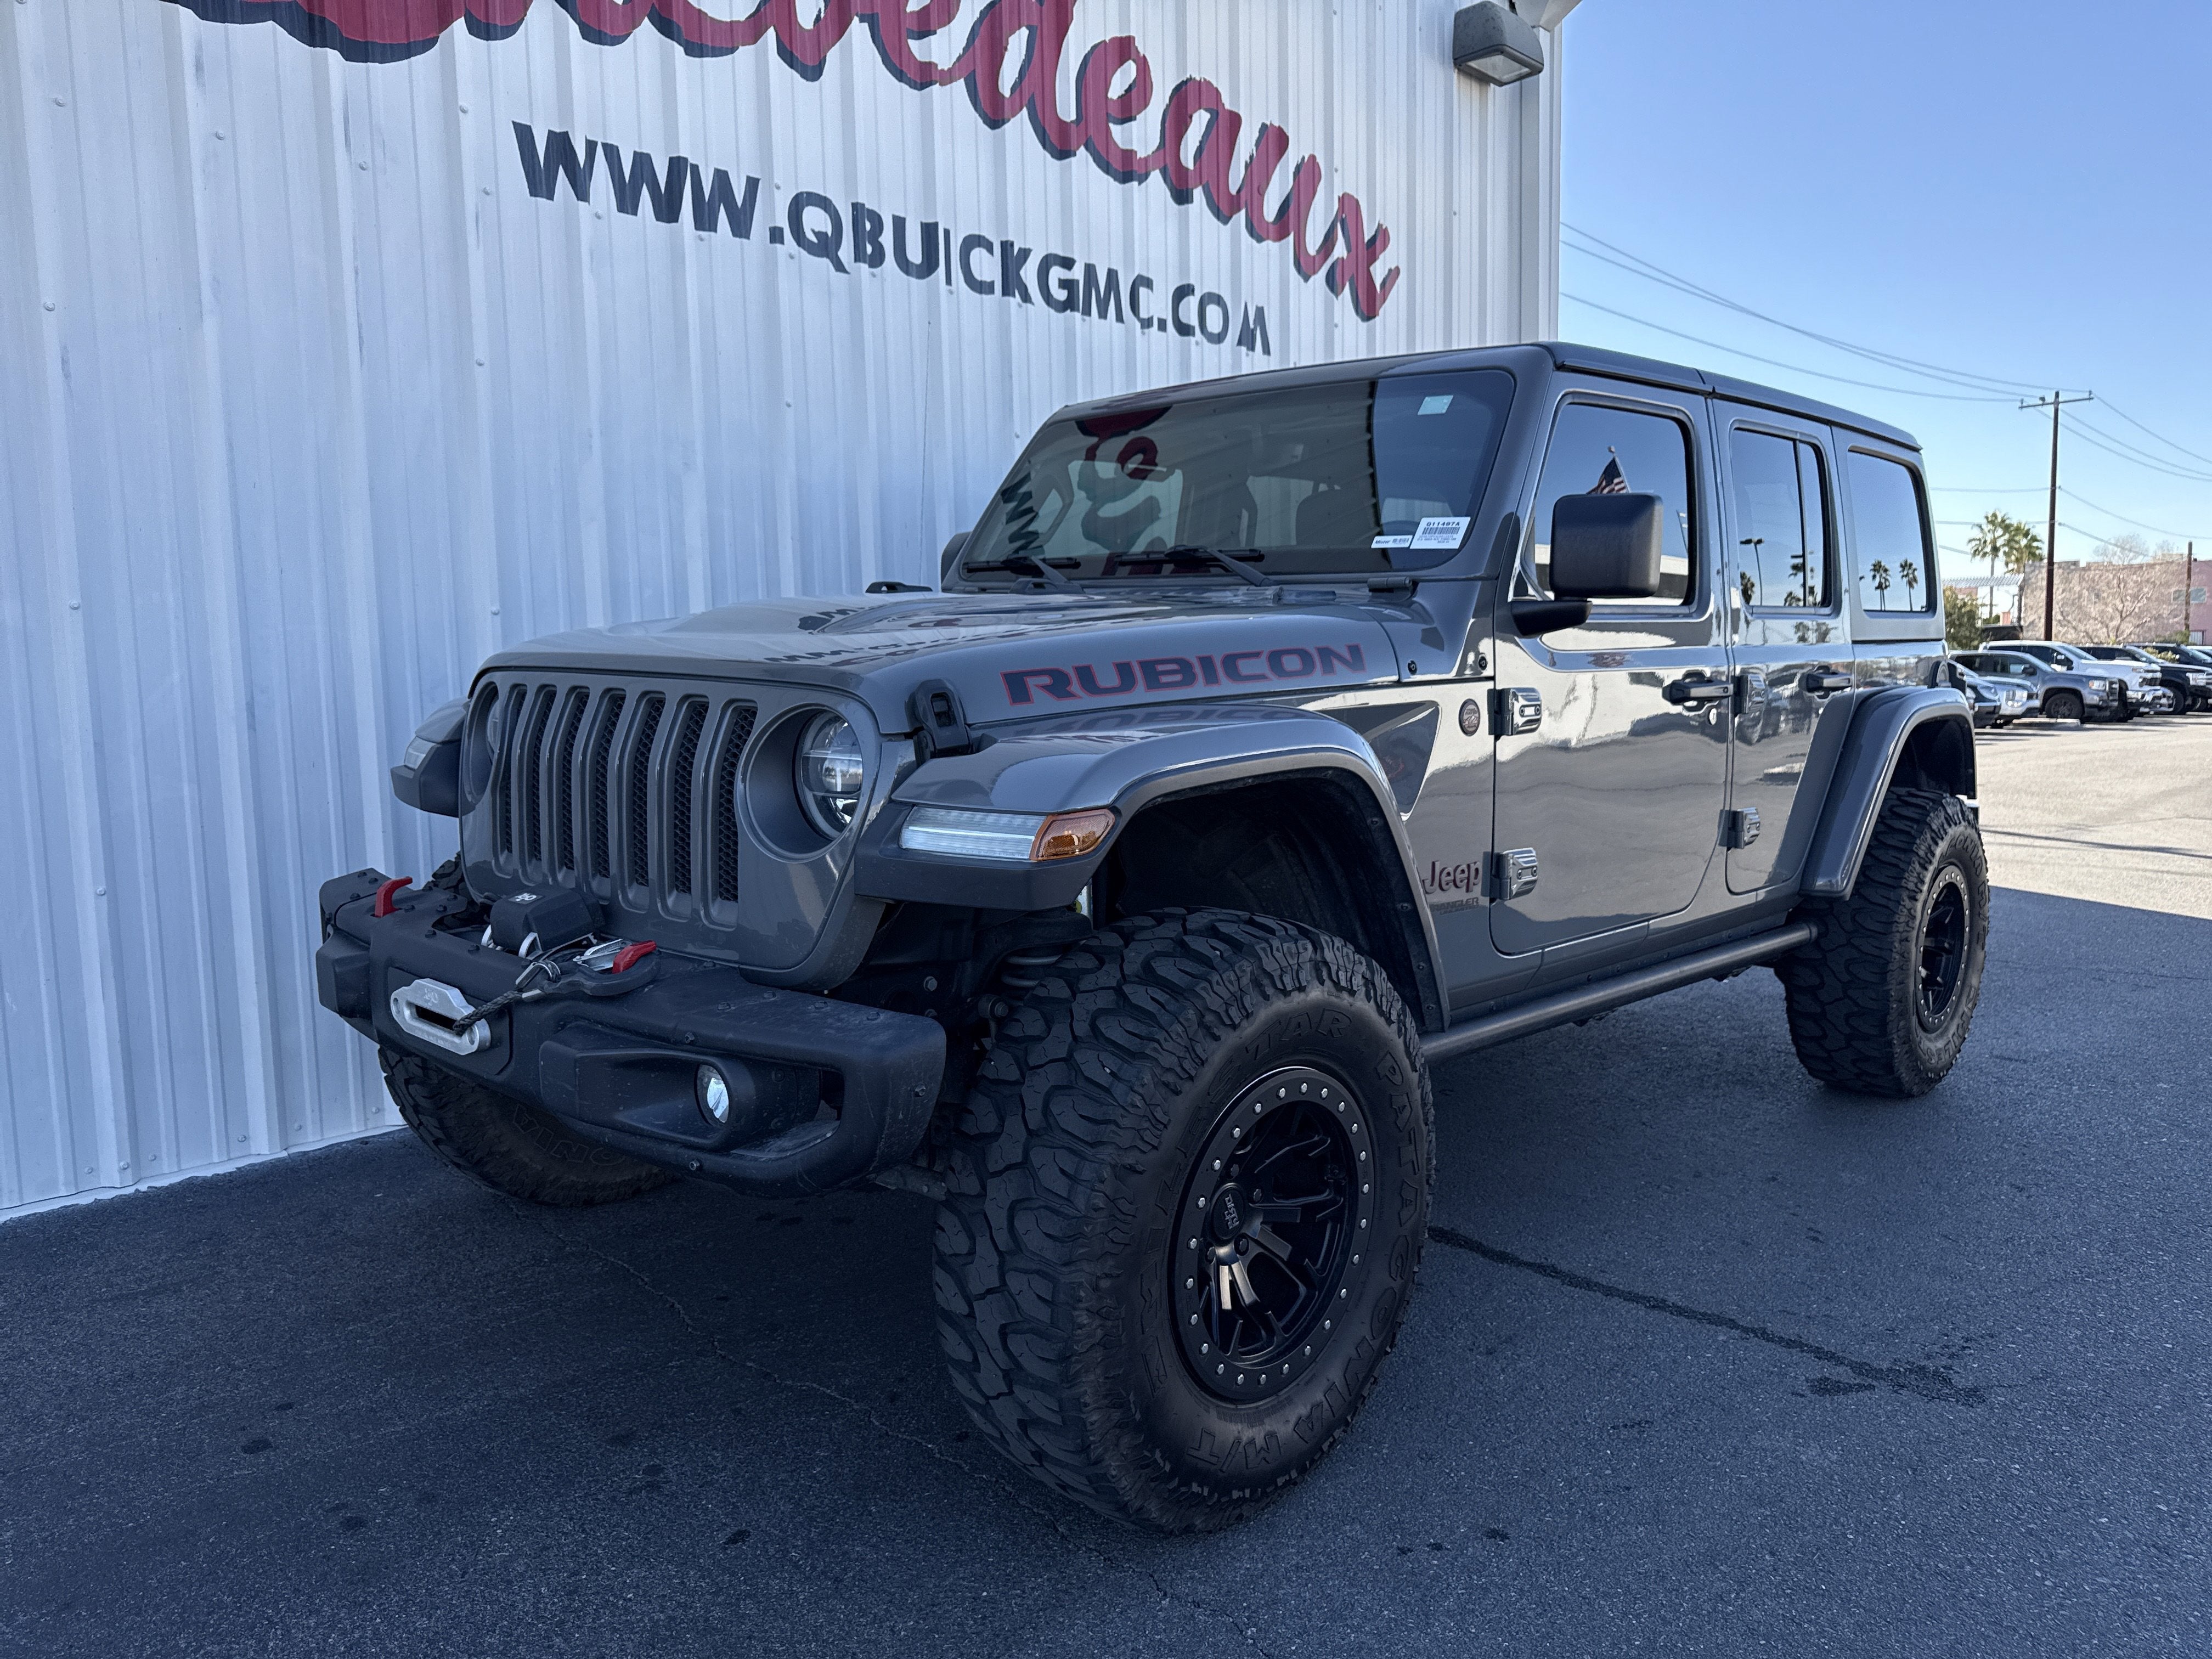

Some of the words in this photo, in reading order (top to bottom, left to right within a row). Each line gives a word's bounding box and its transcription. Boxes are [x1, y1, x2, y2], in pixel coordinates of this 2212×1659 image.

[1000, 644, 1367, 706] RUBICON
[1422, 860, 1480, 894] Jeep
[1294, 1051, 1420, 1443] PATAGONIA
[1187, 1427, 1281, 1472] M/T
